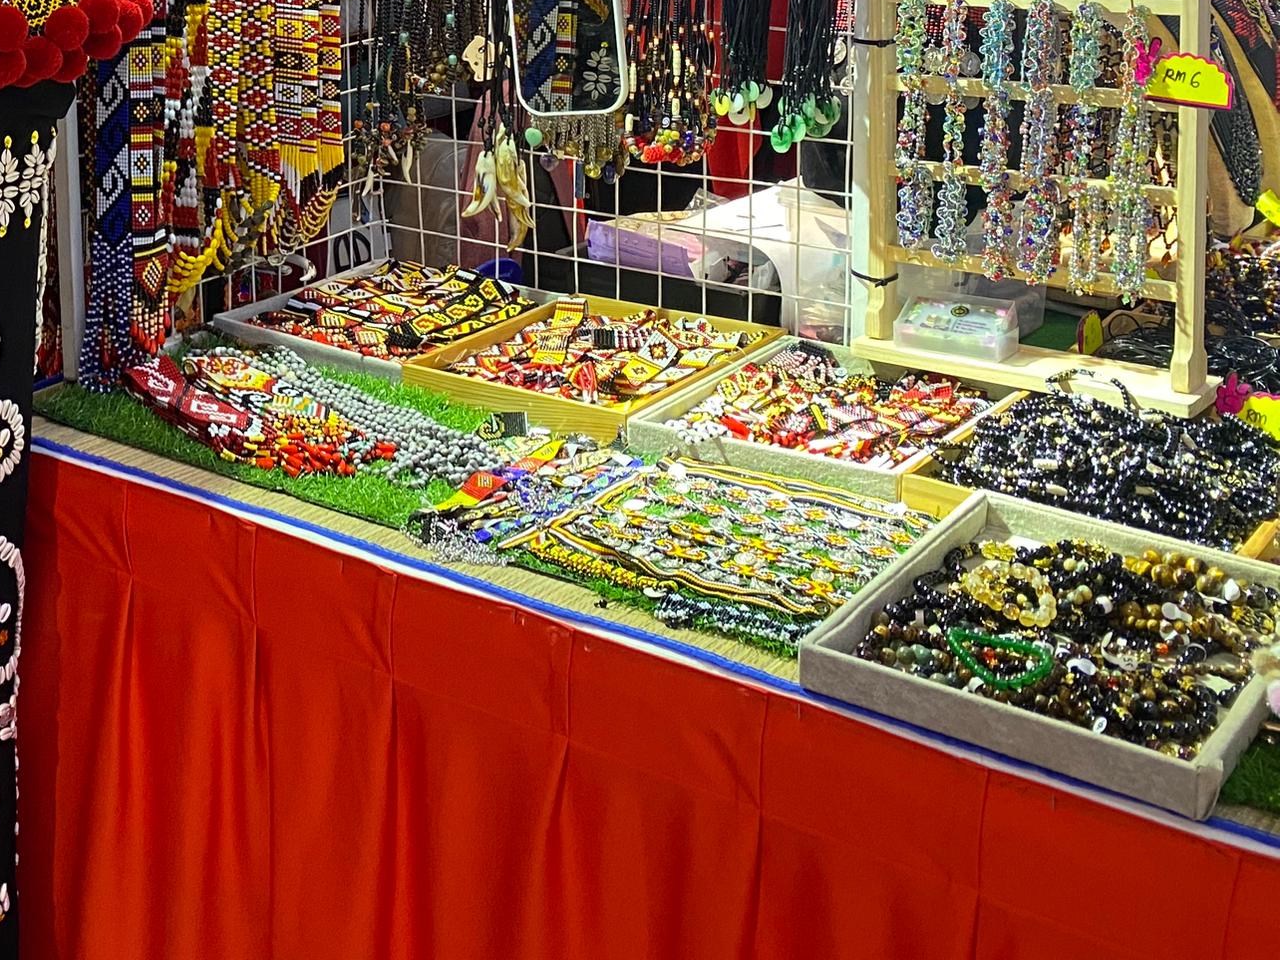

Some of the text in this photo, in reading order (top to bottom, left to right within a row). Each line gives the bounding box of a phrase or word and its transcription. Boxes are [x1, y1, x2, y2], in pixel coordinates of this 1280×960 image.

[1162, 68, 1202, 88] RM 6
[1245, 409, 1267, 425] RM
